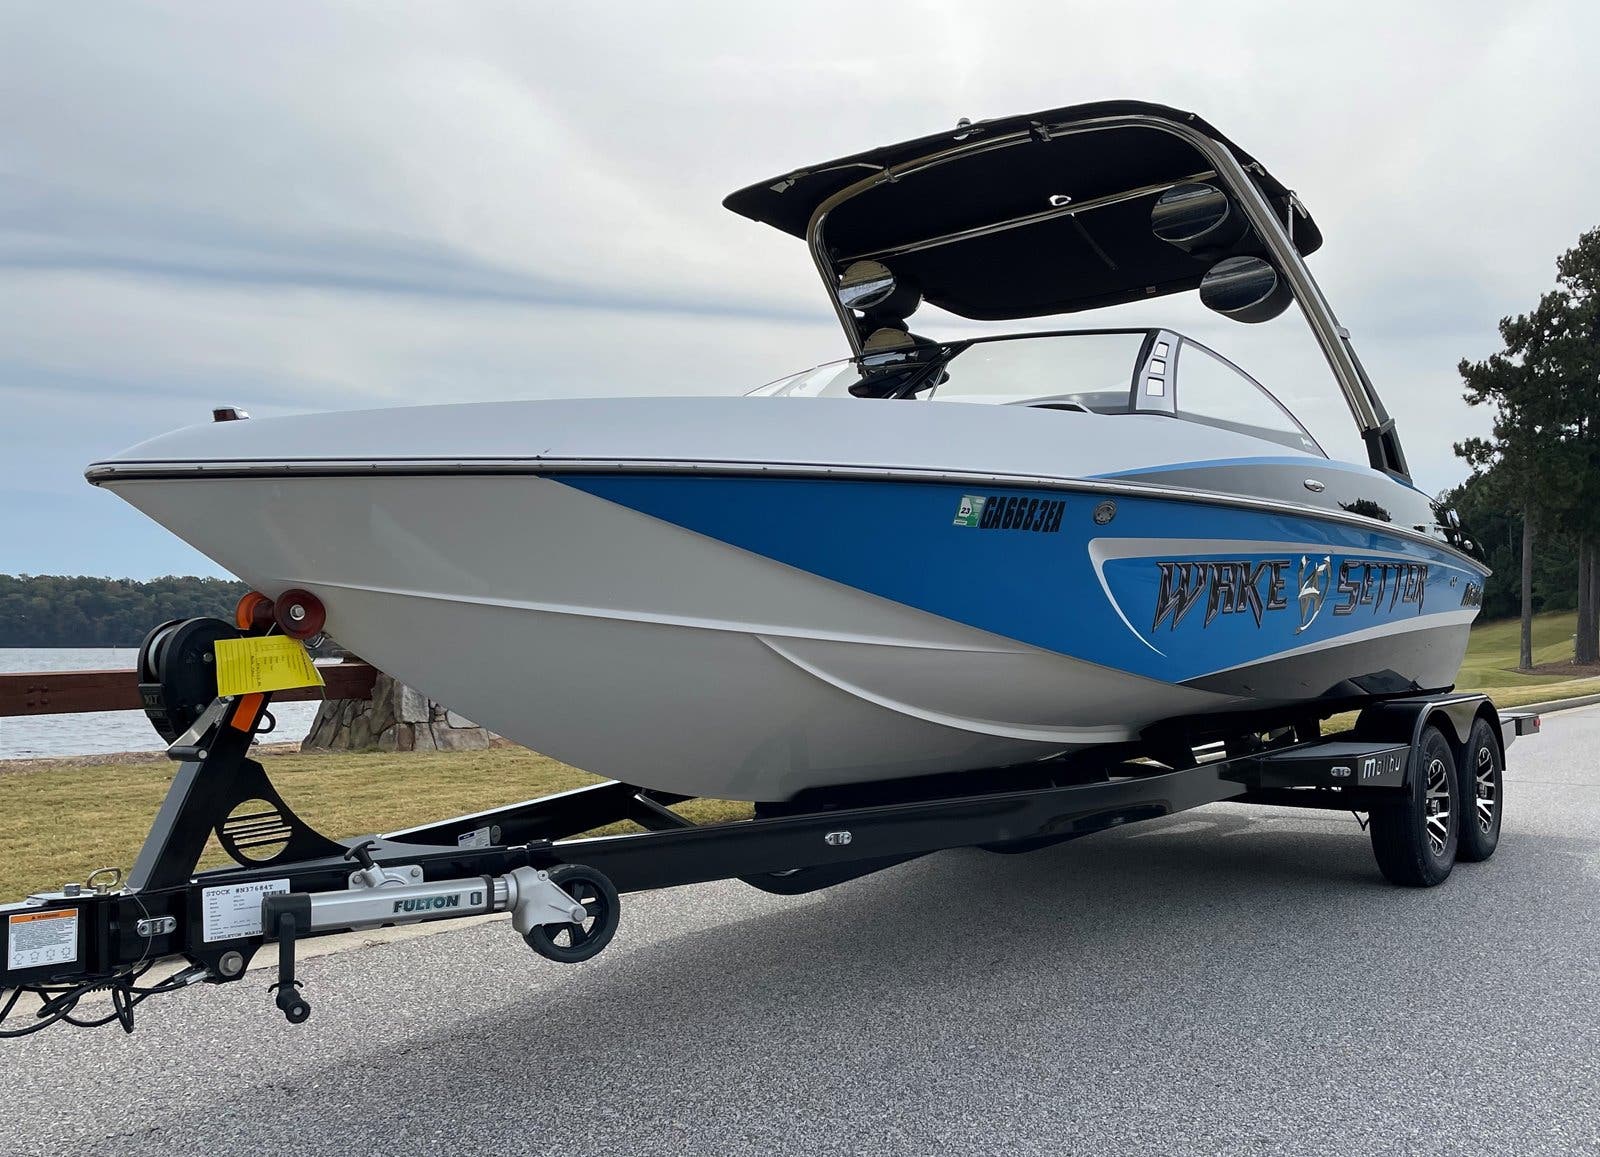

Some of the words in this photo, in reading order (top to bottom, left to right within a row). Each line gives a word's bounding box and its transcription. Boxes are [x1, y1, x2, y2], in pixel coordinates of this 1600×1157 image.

[980, 497, 1066, 532] GA6683EA
[1152, 561, 1290, 633] WAKE
[1333, 559, 1428, 616] SETTER
[393, 895, 459, 913] FULTON
